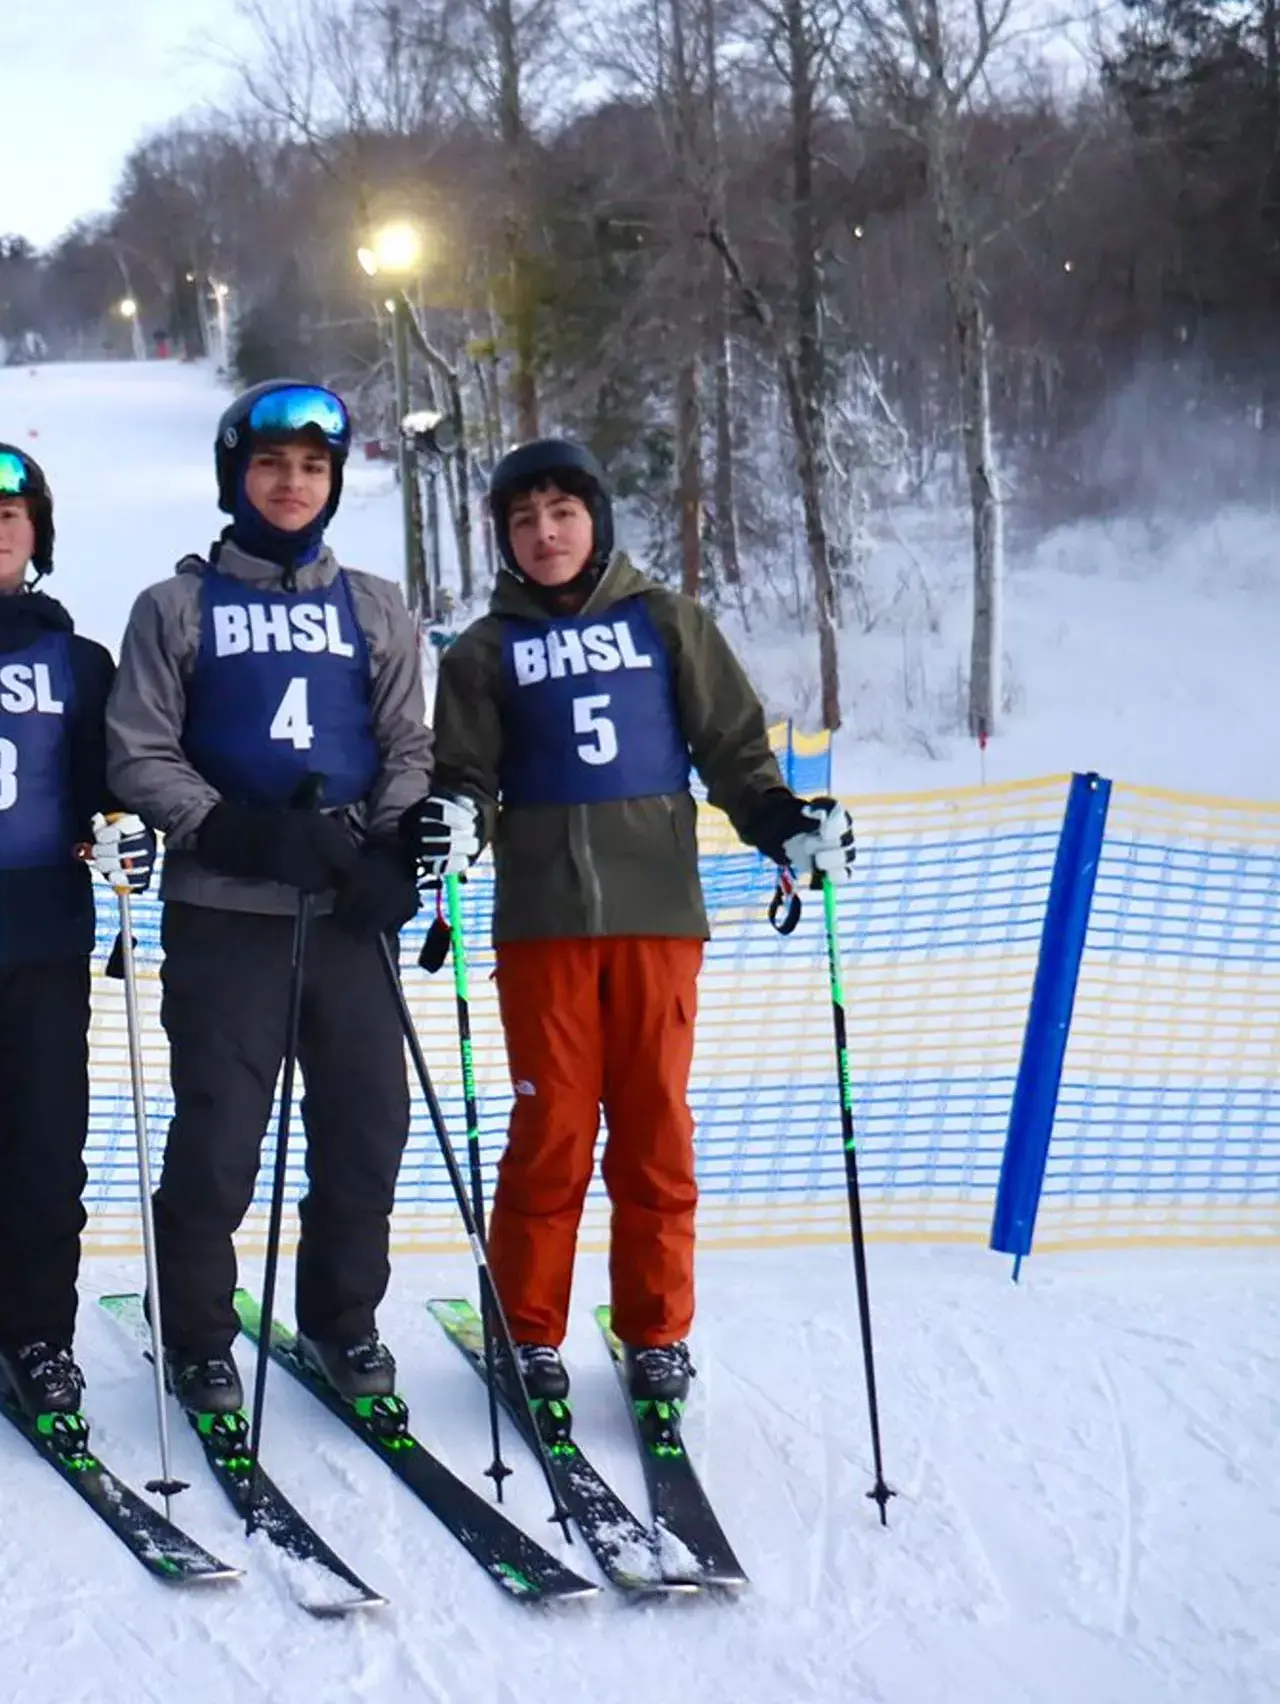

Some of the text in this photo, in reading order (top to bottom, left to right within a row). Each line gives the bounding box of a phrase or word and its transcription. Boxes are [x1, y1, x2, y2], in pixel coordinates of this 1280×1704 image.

[213, 603, 355, 658] BHSL
[513, 621, 653, 685] BHSL
[268, 677, 315, 750] 4
[573, 694, 618, 765] 5
